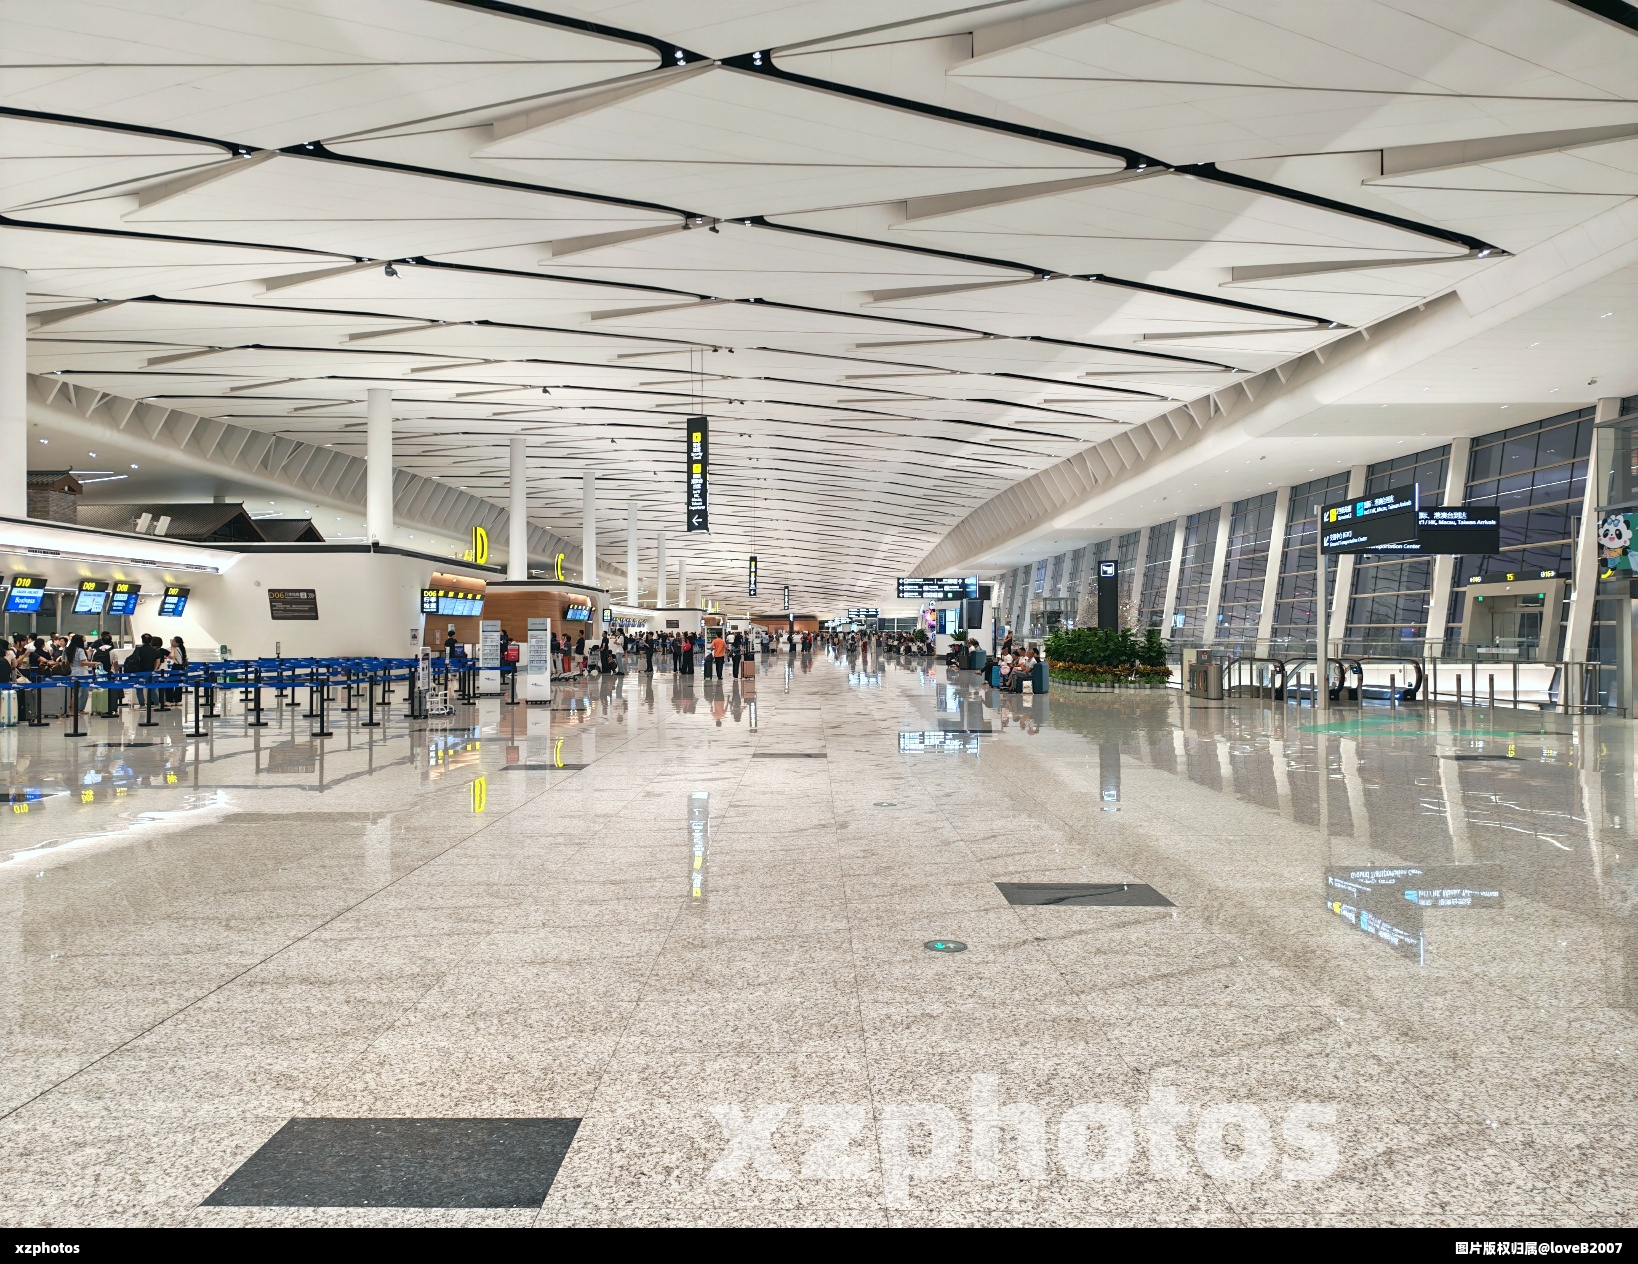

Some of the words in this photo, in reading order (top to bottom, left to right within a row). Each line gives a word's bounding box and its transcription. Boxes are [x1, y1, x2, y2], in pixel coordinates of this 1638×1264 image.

[472, 526, 488, 564] D
[15, 577, 31, 587] D10
[82, 581, 96, 590] D09
